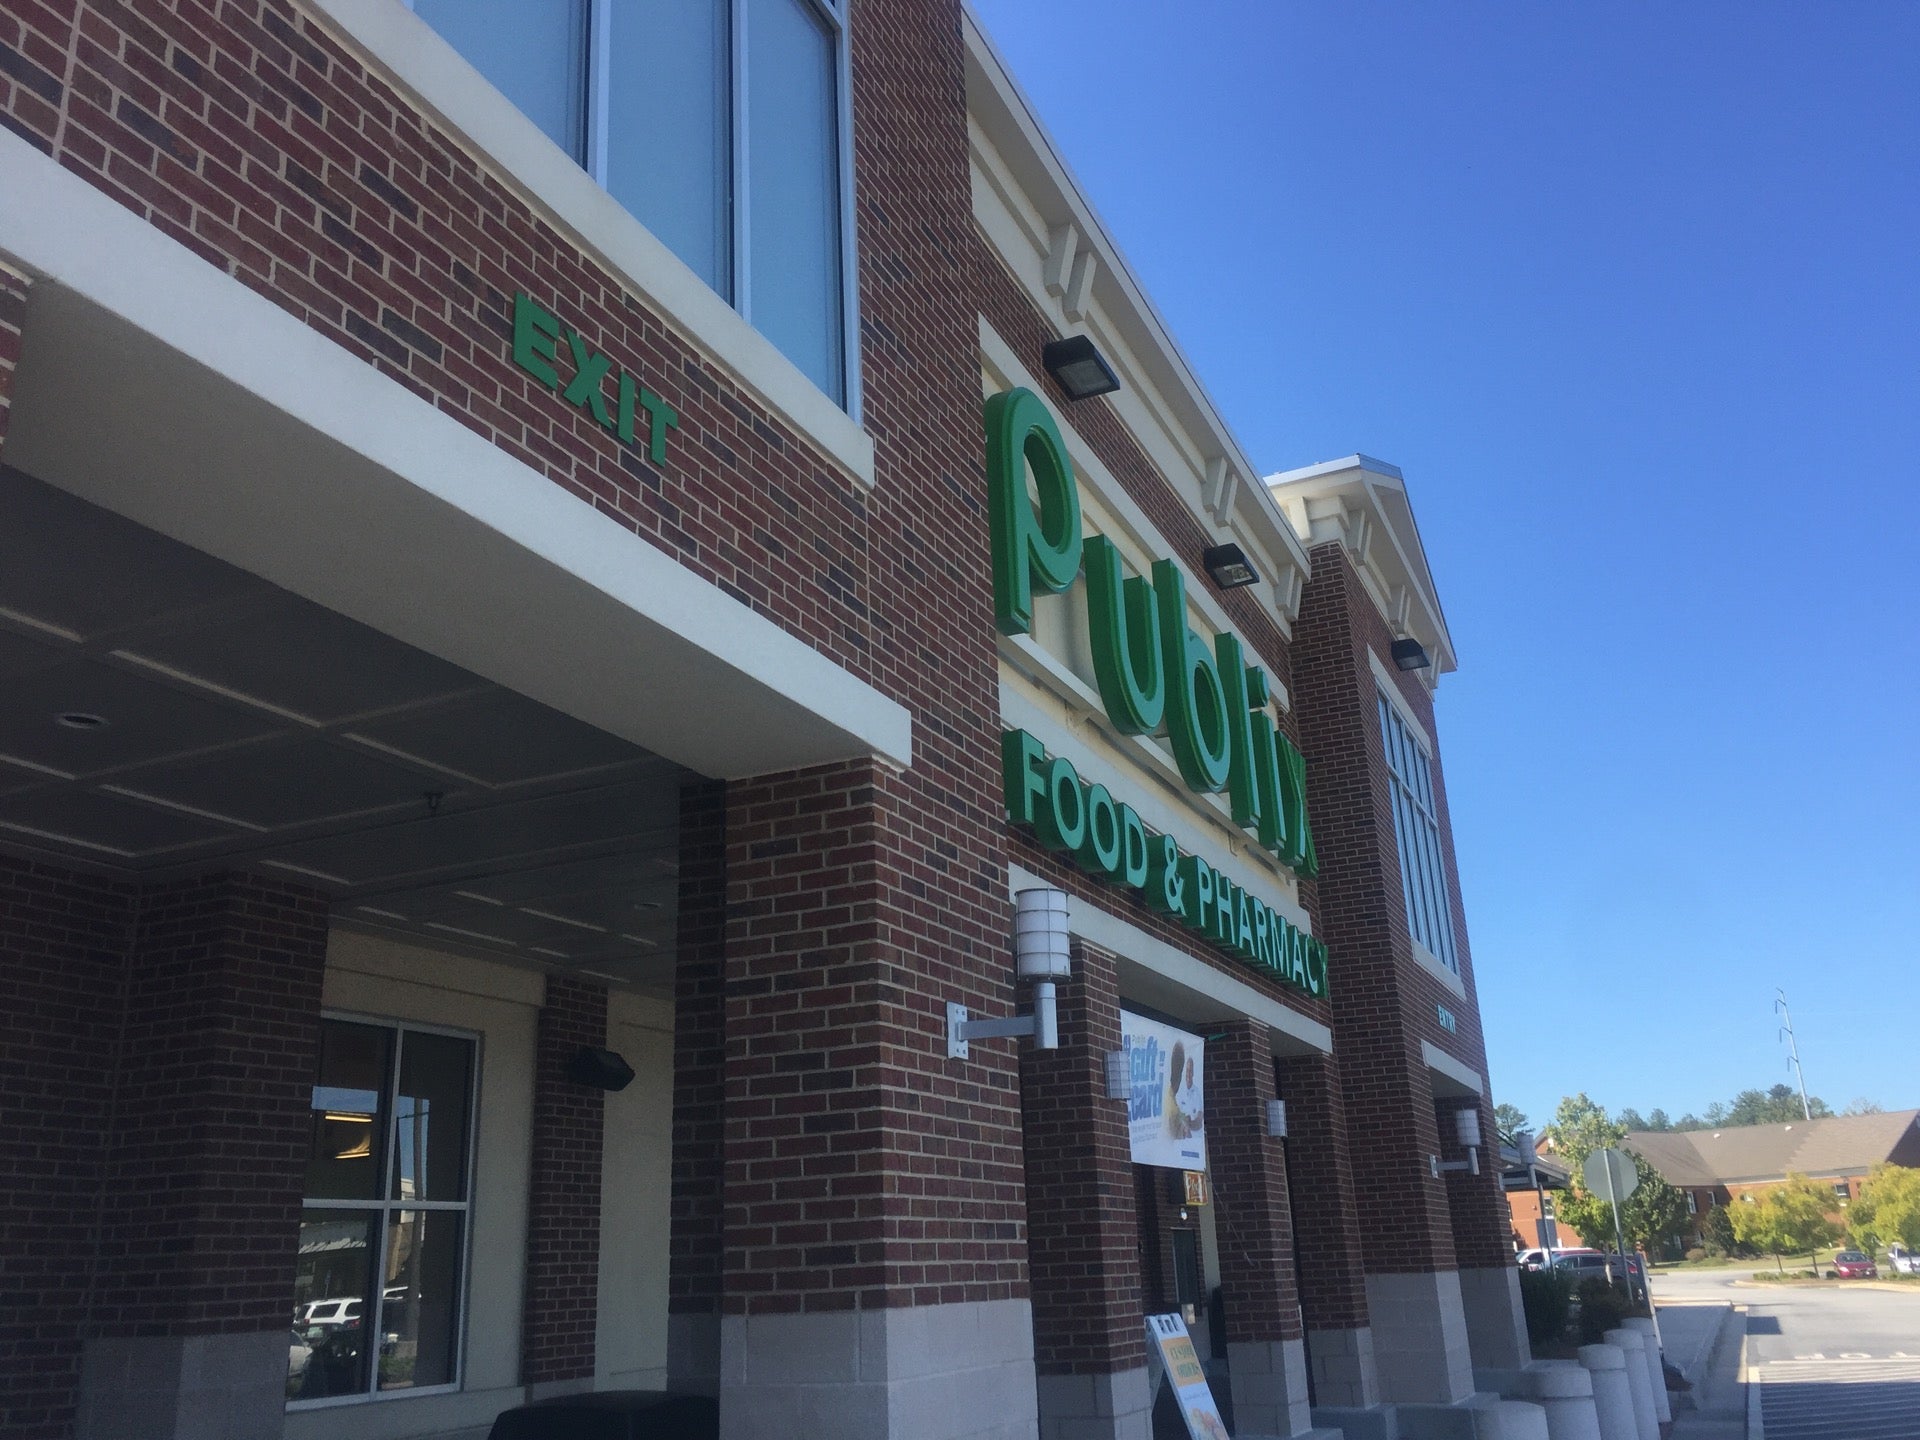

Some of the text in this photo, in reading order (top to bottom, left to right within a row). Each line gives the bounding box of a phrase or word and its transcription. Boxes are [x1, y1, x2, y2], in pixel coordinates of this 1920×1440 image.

[512, 291, 679, 468] EXIT
[985, 387, 1318, 880] Publix
[1003, 729, 1328, 998] FOOD & PHARMACY
